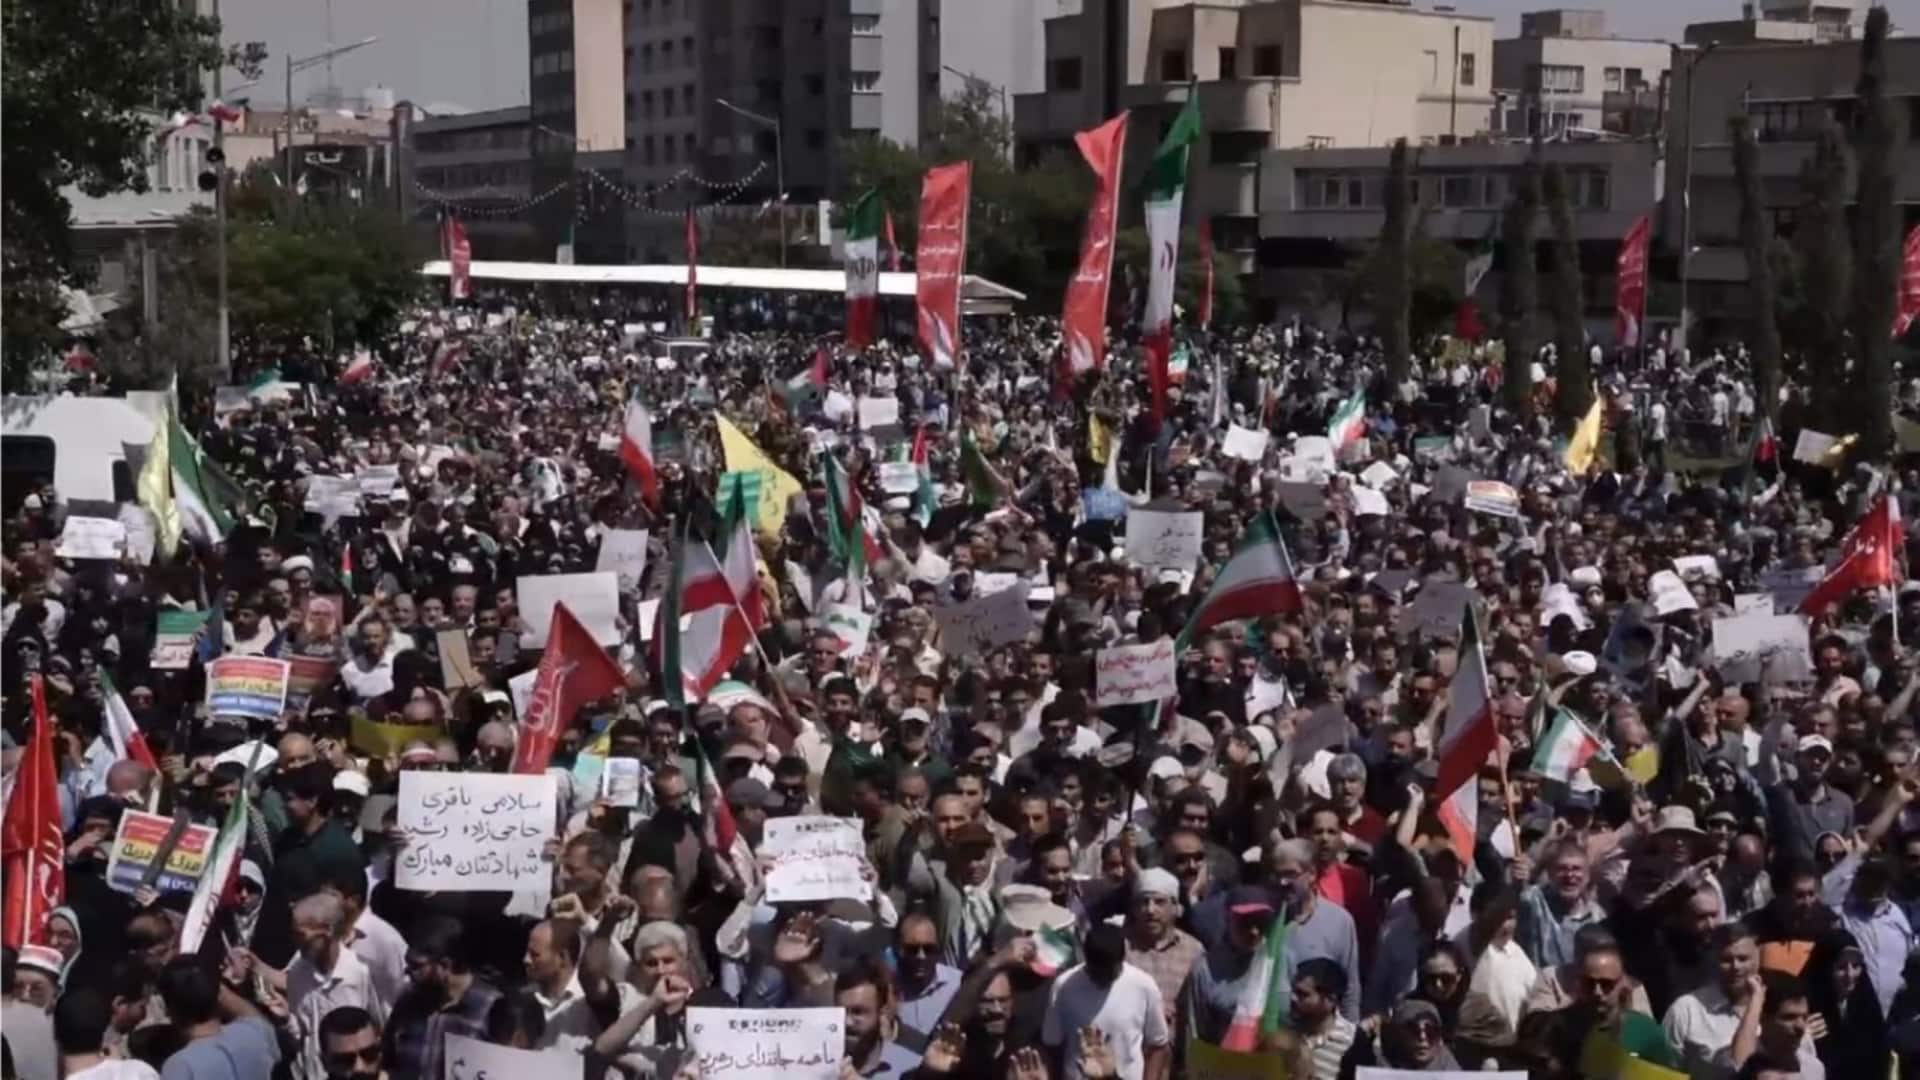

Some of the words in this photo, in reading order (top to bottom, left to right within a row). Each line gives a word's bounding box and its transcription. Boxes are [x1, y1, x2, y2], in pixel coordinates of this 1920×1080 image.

[422, 786, 472, 815] باقری
[481, 793, 542, 814] سلامی
[403, 843, 453, 876] مبارک
[456, 849, 539, 880] شهادتتان
